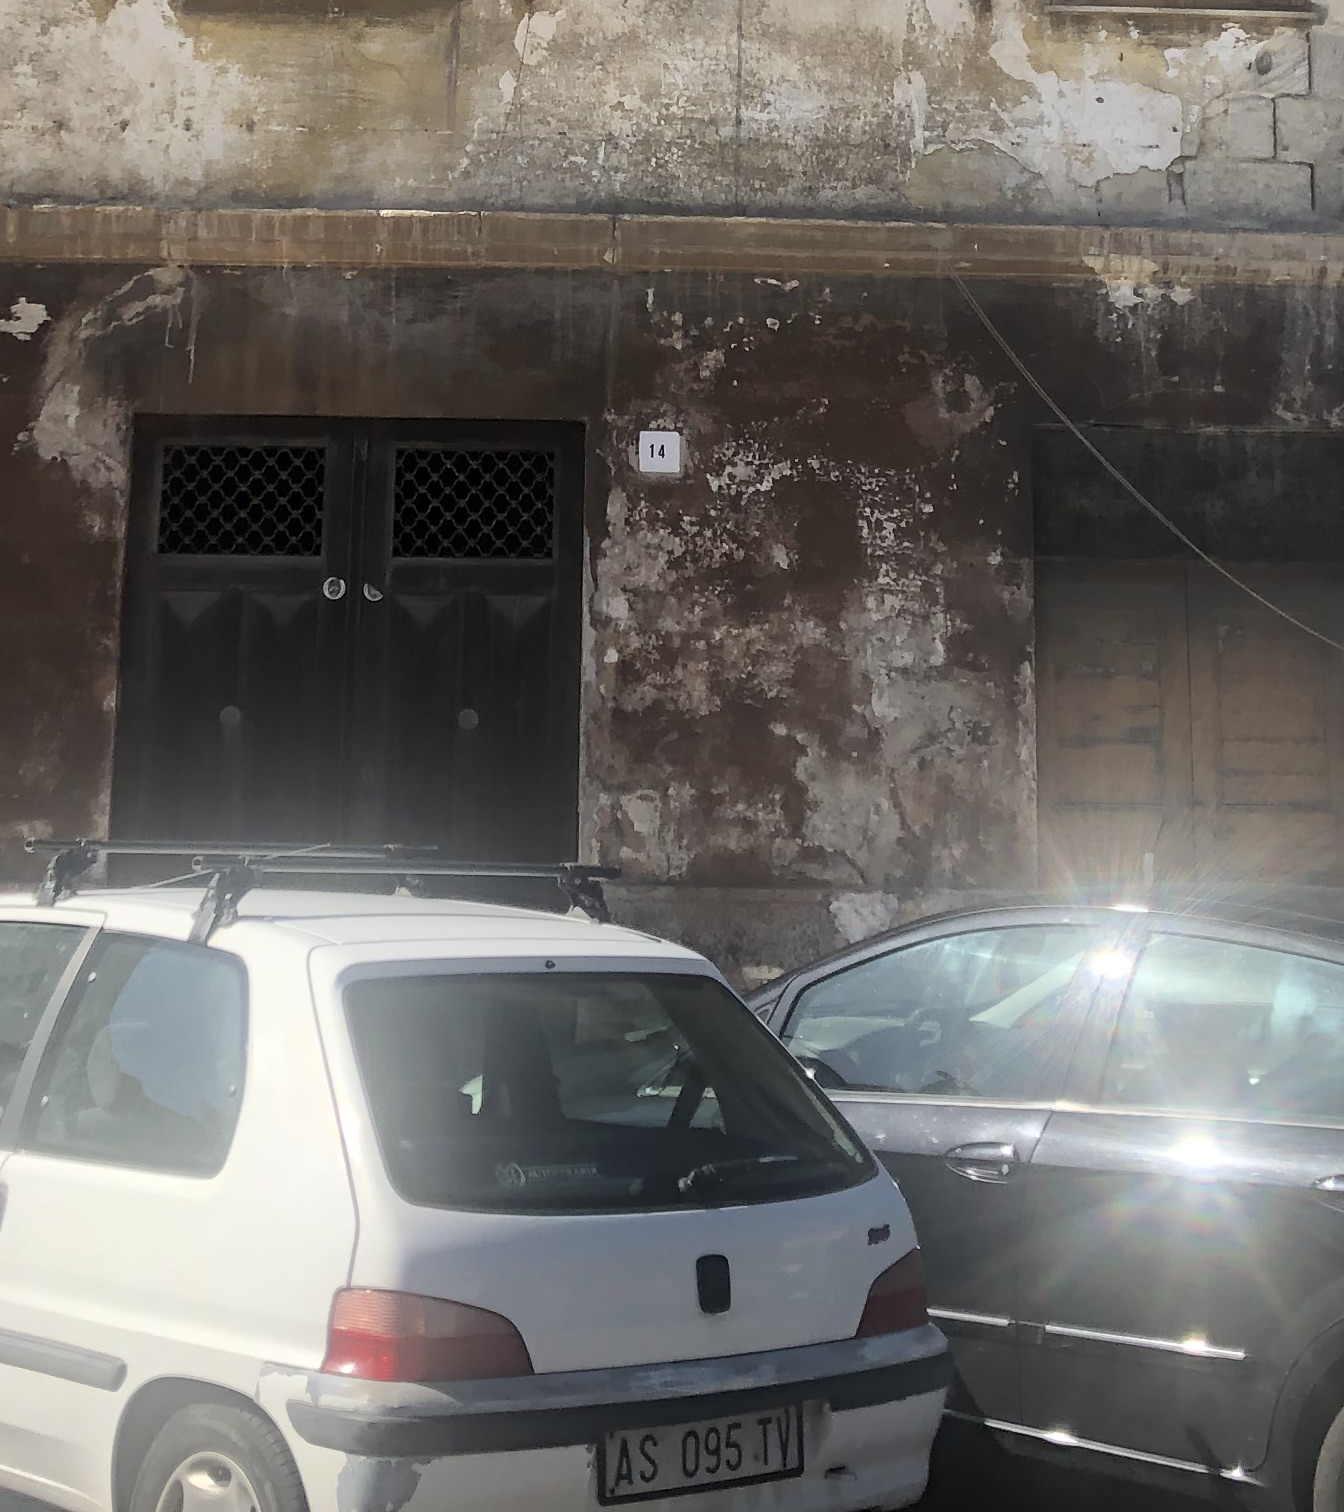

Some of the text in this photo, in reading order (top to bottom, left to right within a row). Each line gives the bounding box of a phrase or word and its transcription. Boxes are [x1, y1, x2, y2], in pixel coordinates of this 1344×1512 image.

[649, 443, 666, 459] 14
[614, 1407, 792, 1487] AS 095 TV
